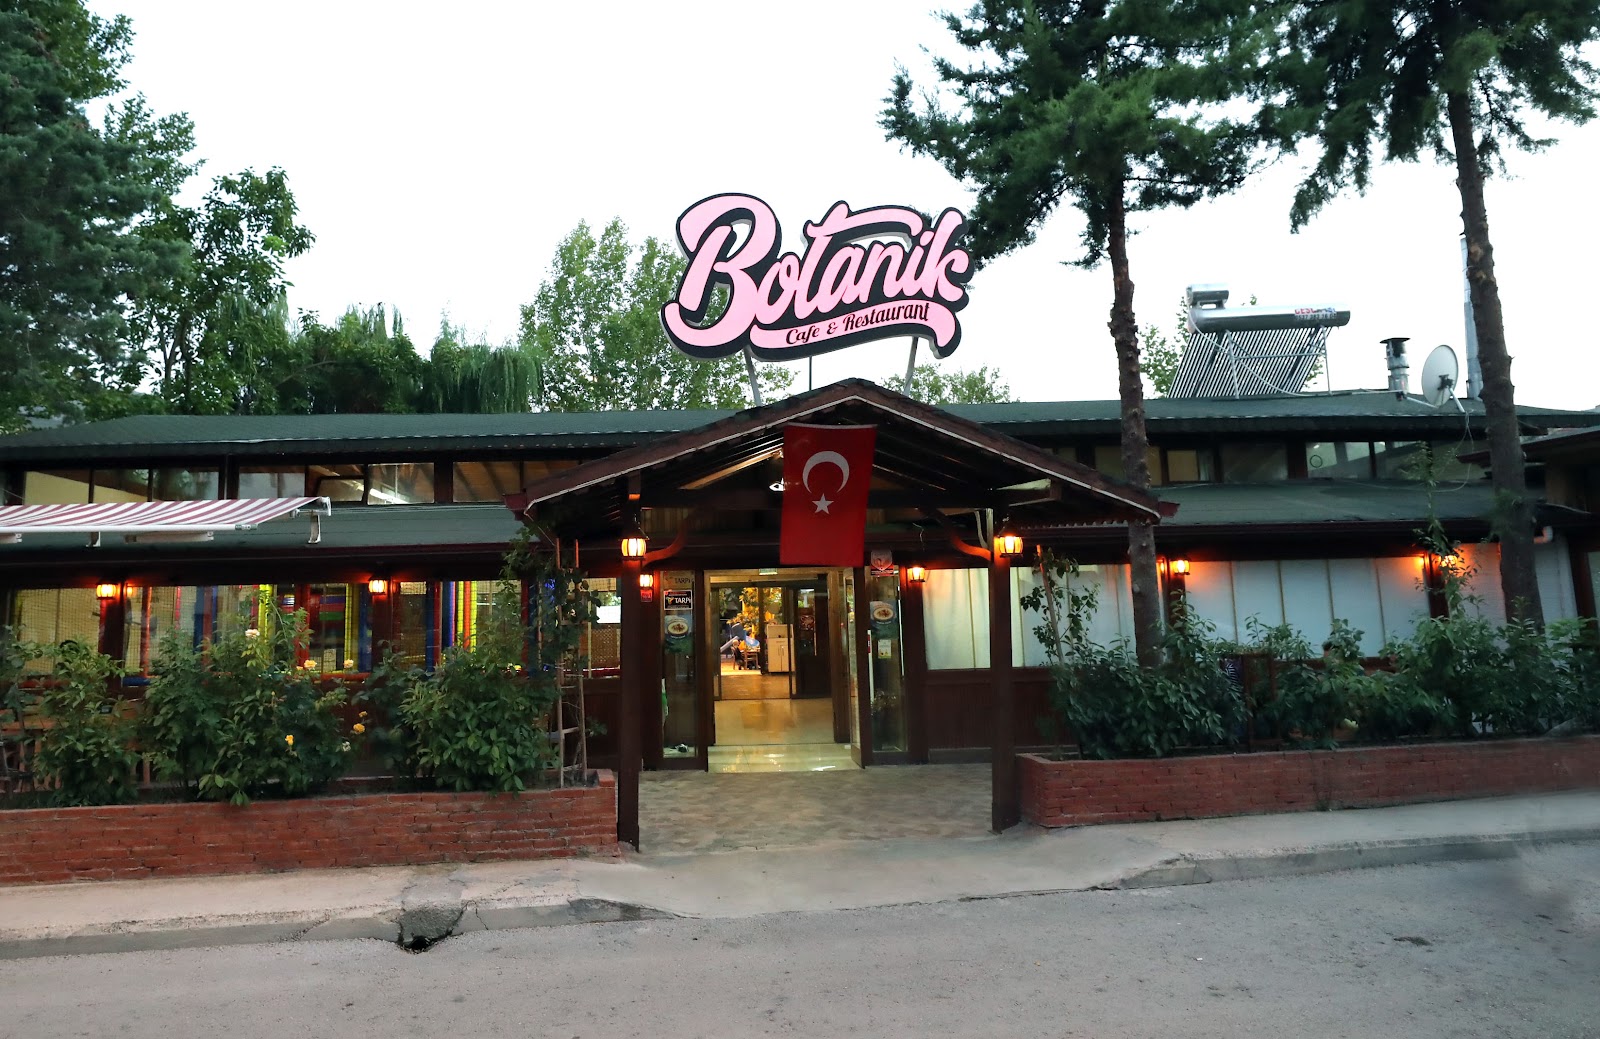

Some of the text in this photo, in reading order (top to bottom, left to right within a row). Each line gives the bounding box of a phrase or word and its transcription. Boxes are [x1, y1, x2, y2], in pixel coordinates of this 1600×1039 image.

[663, 193, 972, 348] Botanik
[786, 303, 930, 344] Cafe & Restaurant
